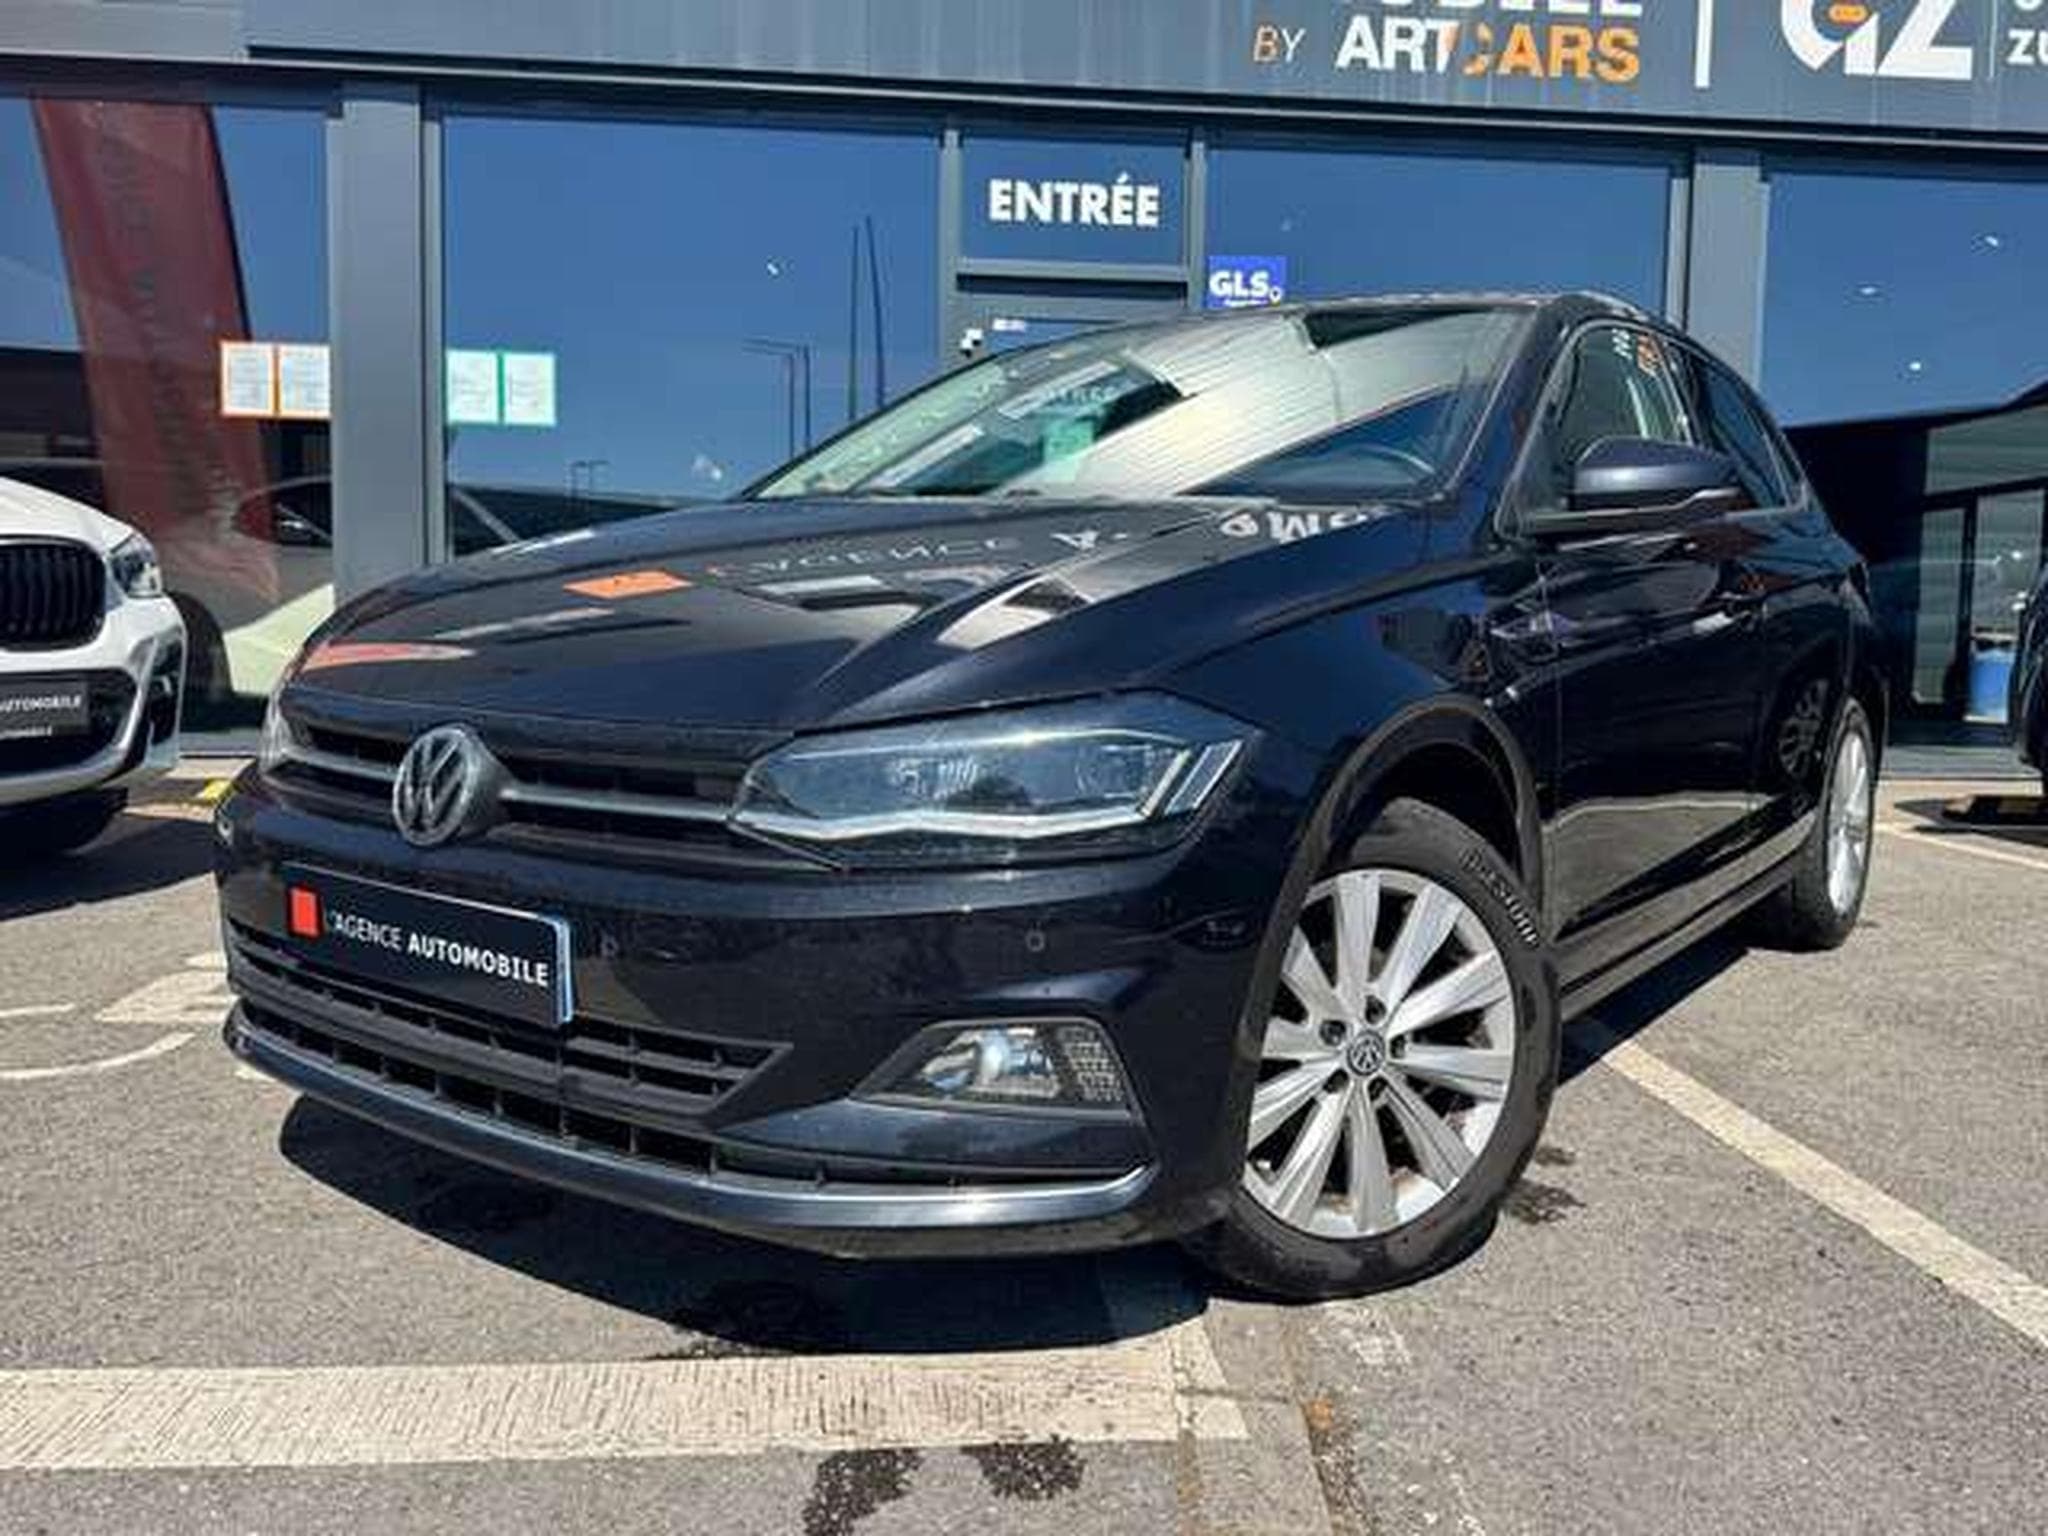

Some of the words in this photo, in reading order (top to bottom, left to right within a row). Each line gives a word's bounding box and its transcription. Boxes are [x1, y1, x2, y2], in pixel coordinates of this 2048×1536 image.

[1253, 25, 1306, 63] BY
[988, 170, 1160, 228] ENTRÉE
[407, 932, 549, 987] AUTOMOBILE
